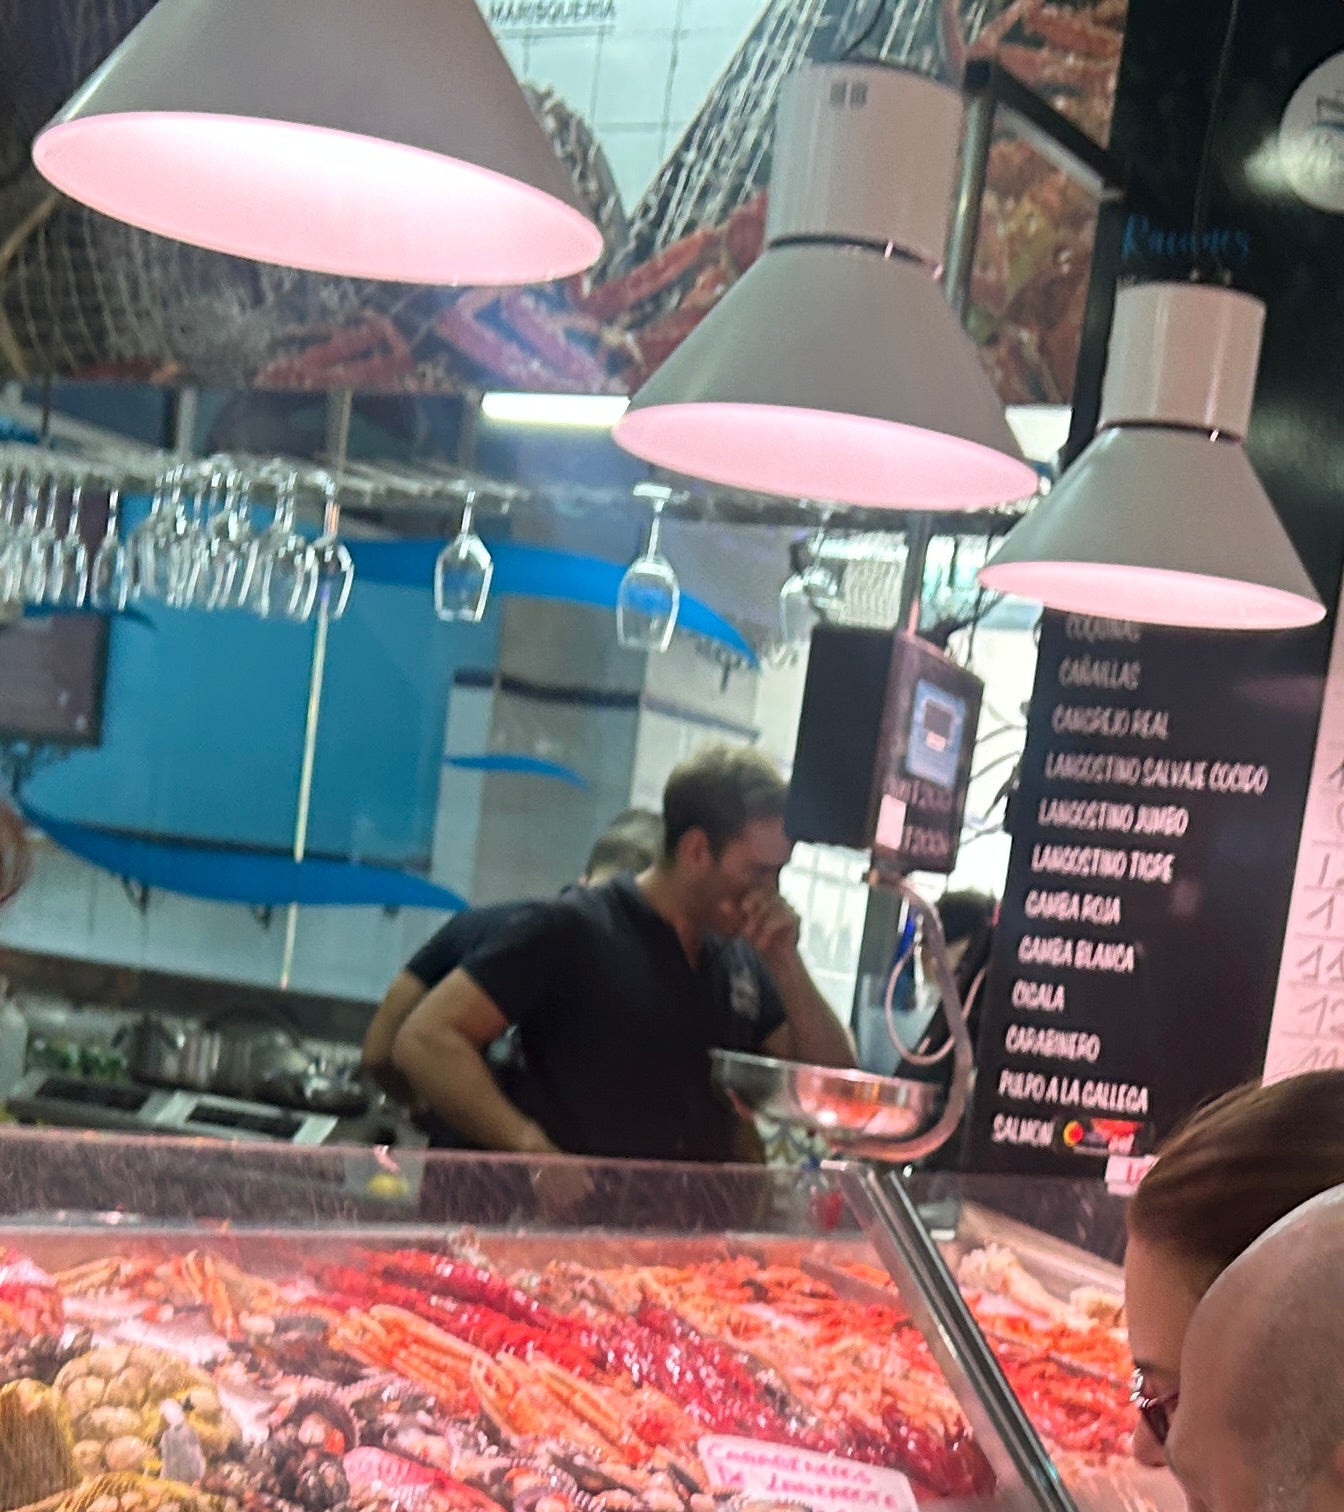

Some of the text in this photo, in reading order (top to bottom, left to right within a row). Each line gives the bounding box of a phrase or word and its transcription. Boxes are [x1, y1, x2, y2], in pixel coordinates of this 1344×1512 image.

[1045, 752, 1269, 796] LANGOSTINO SALVAJE COCIDO
[1038, 798, 1189, 838] LANGOSTINO JUMBO
[1031, 843, 1175, 884] LANGOSTINO TIGRE
[1024, 889, 1121, 925] GAMBA ROJA
[1018, 934, 1135, 972] GAMBA BLANCA
[1006, 1023, 1101, 1064] CARABINERO
[999, 1068, 1148, 1115] PULPO A LA GALLEGA
